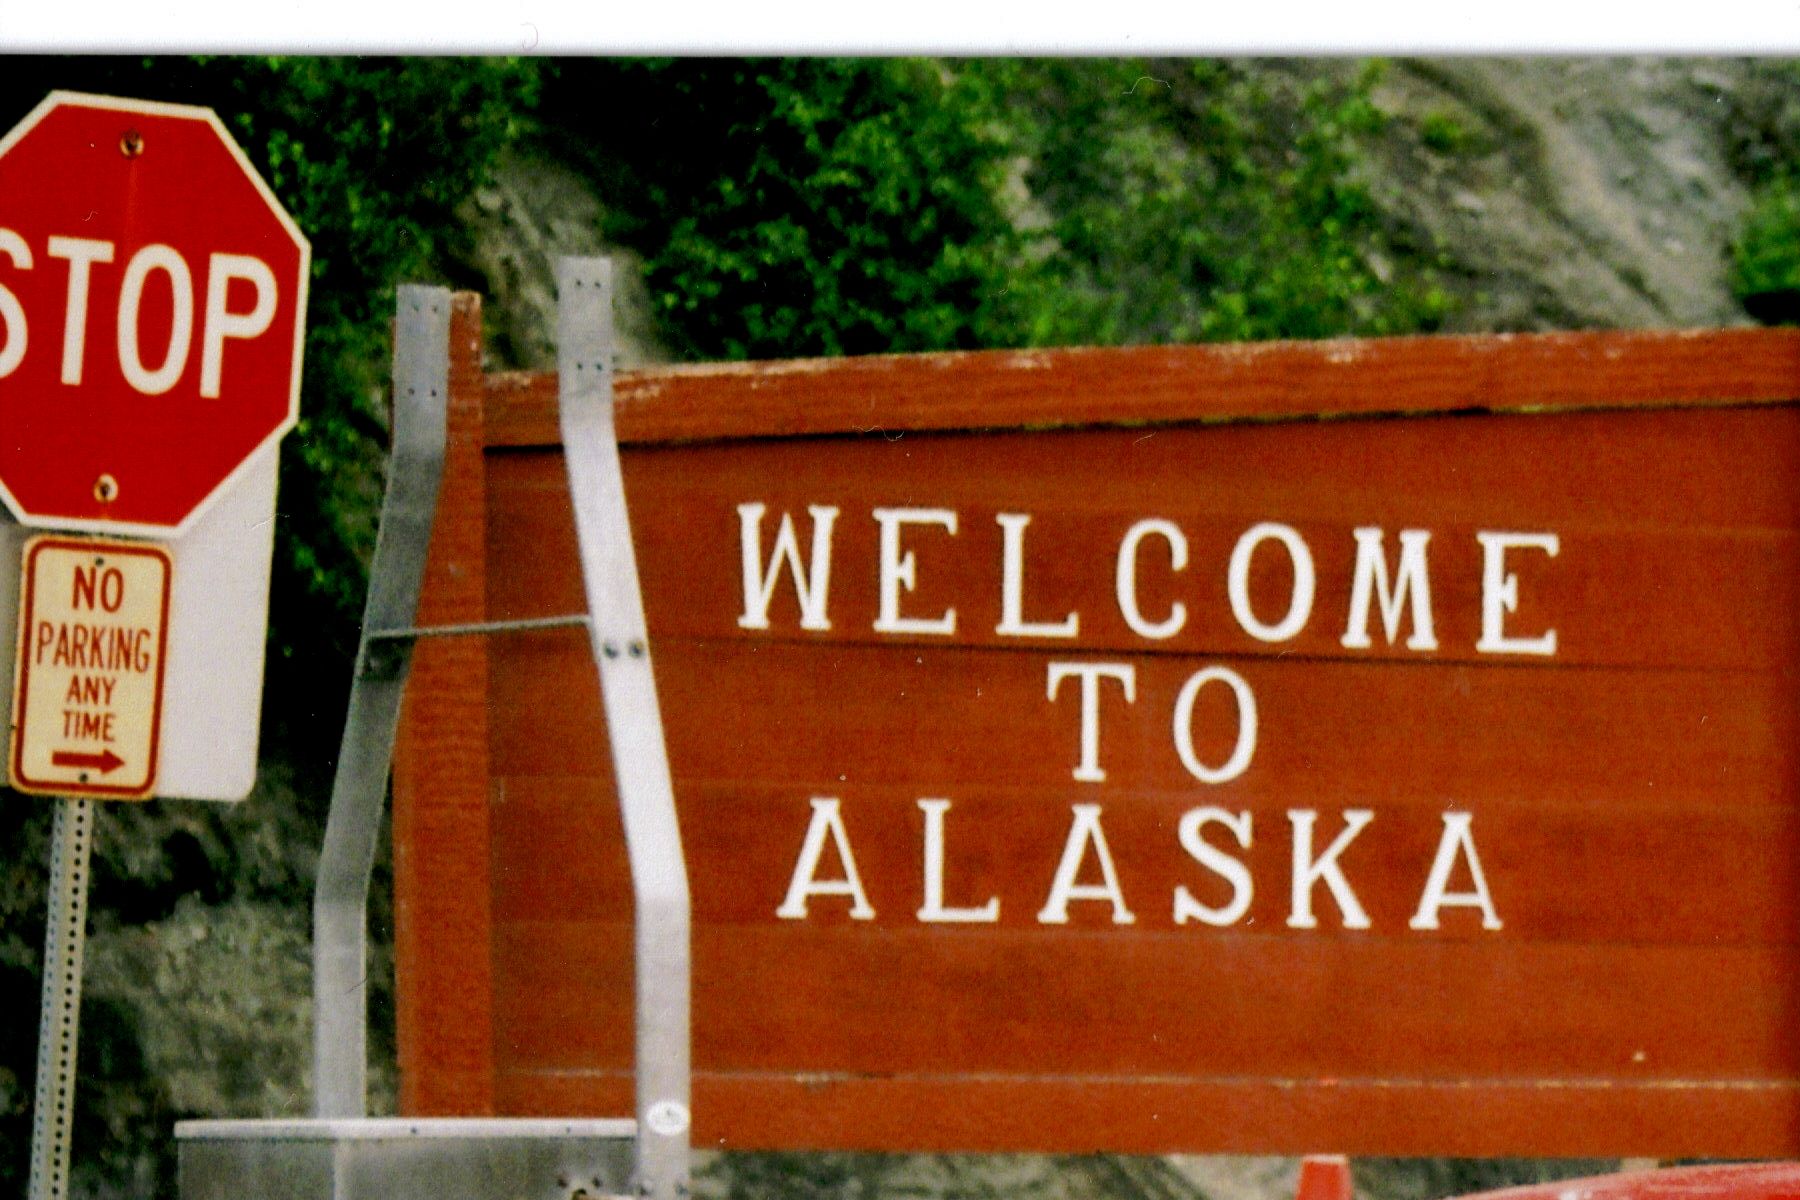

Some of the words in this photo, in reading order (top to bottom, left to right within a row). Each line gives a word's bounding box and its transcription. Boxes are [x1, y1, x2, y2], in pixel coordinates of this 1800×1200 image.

[72, 566, 124, 613] NO
[736, 501, 1560, 656] WELCOME
[36, 621, 151, 673] PARKING
[66, 674, 116, 705] ANY
[62, 709, 116, 742] TIME
[1045, 661, 1259, 785] TO
[775, 796, 1503, 931] ALASKA
